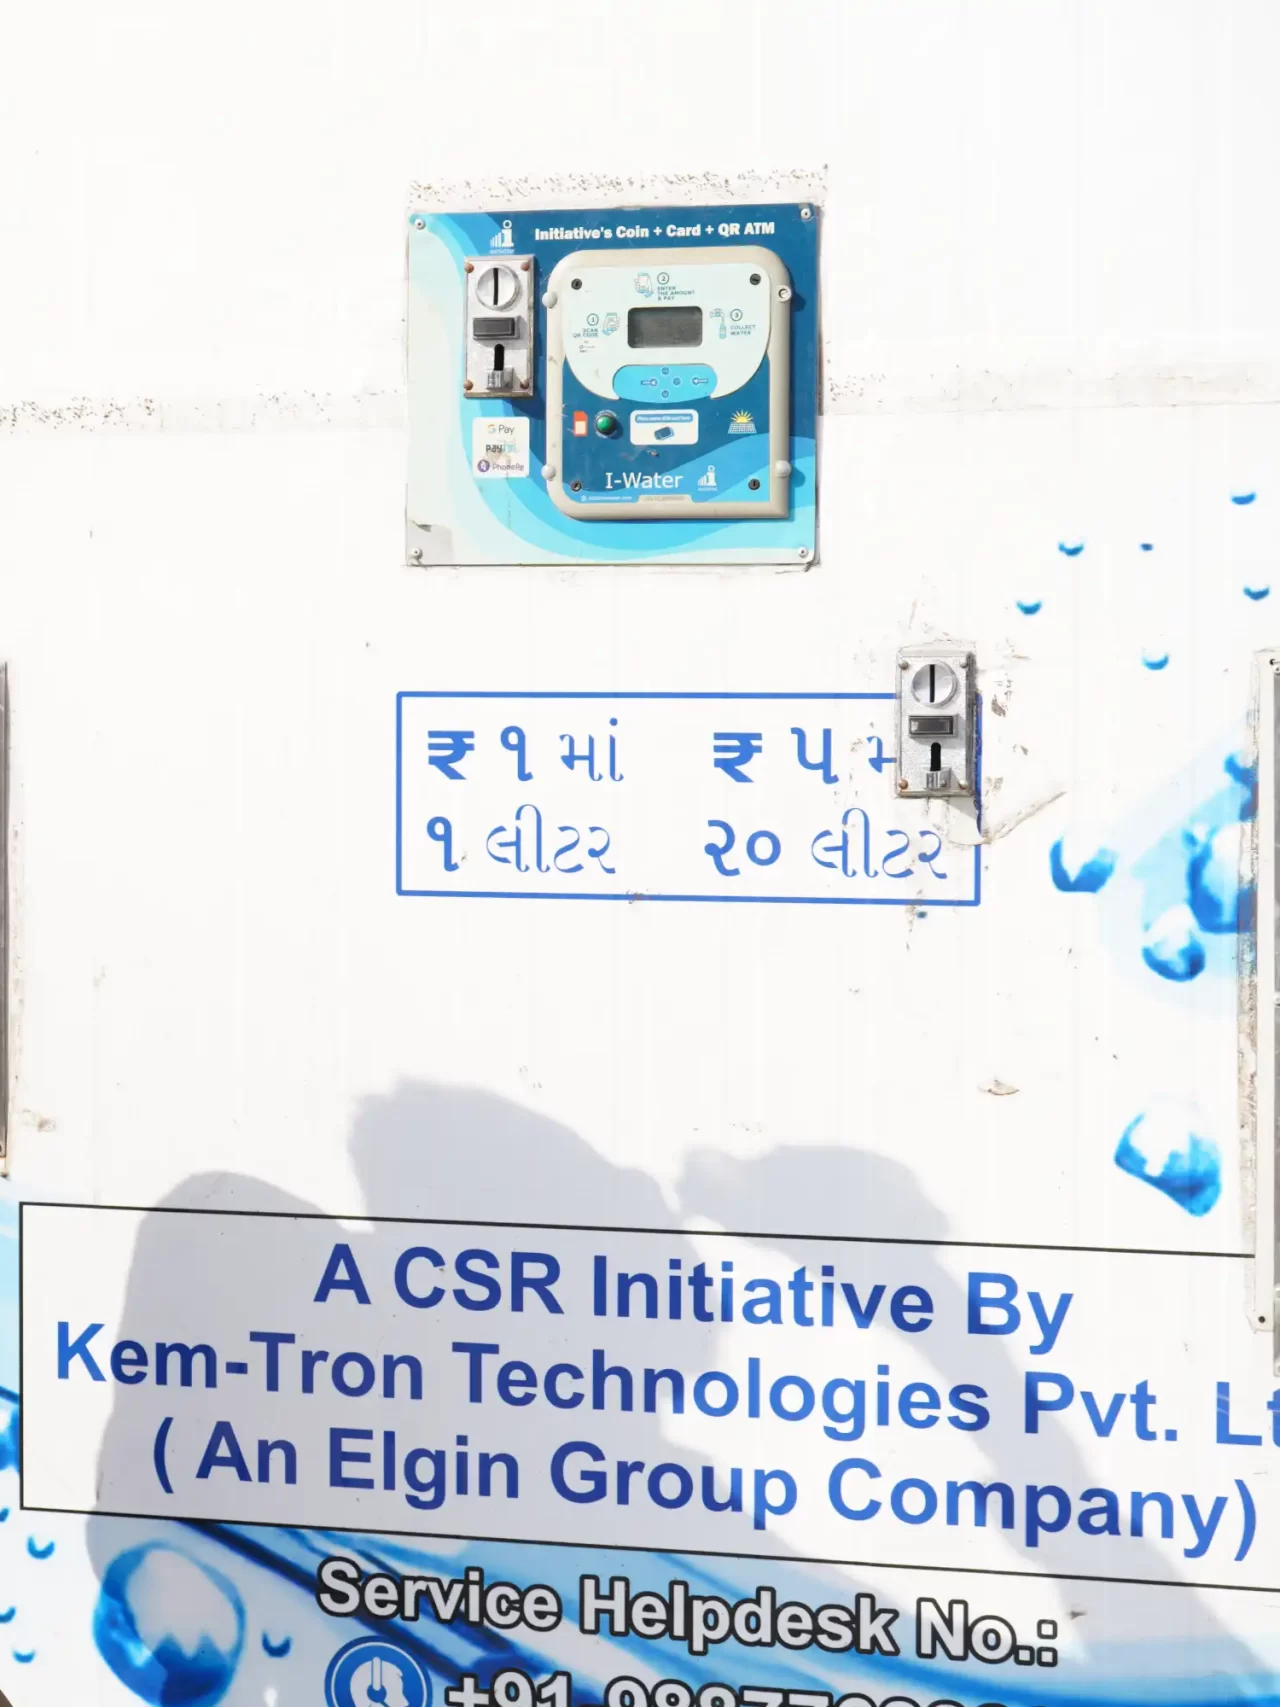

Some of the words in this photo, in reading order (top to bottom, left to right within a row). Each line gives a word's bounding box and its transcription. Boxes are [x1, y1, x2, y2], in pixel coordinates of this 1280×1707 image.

[535, 227, 612, 241] Initiative's
[616, 225, 649, 239] Coin
[653, 227, 662, 236] +
[666, 223, 701, 238] Card
[705, 226, 714, 235] +
[718, 223, 740, 237] QR
[744, 222, 775, 235] ATM
[498, 424, 515, 435] Pay
[605, 472, 684, 489] I-Water
[500, 725, 533, 782] ૧
[426, 816, 459, 872] ૧
[487, 804, 616, 874] લીટર
[703, 819, 782, 877] ૨૦
[812, 808, 948, 880] લીટર
[314, 1243, 370, 1305] A
[394, 1246, 562, 1315] CSR
[593, 1255, 934, 1333] Initiative
[966, 1271, 1074, 1356] By
[56, 1321, 424, 1401] Kem-Tron
[452, 1341, 991, 1442] Technologies
[1024, 1370, 1178, 1443] Pvt.
[329, 1428, 520, 1510] Elgin
[550, 1441, 799, 1531] Group
[827, 1457, 1256, 1562] Company)
[316, 1556, 562, 1632] Service
[579, 1574, 900, 1657] Helpdesk
[916, 1596, 1058, 1667] No.:
